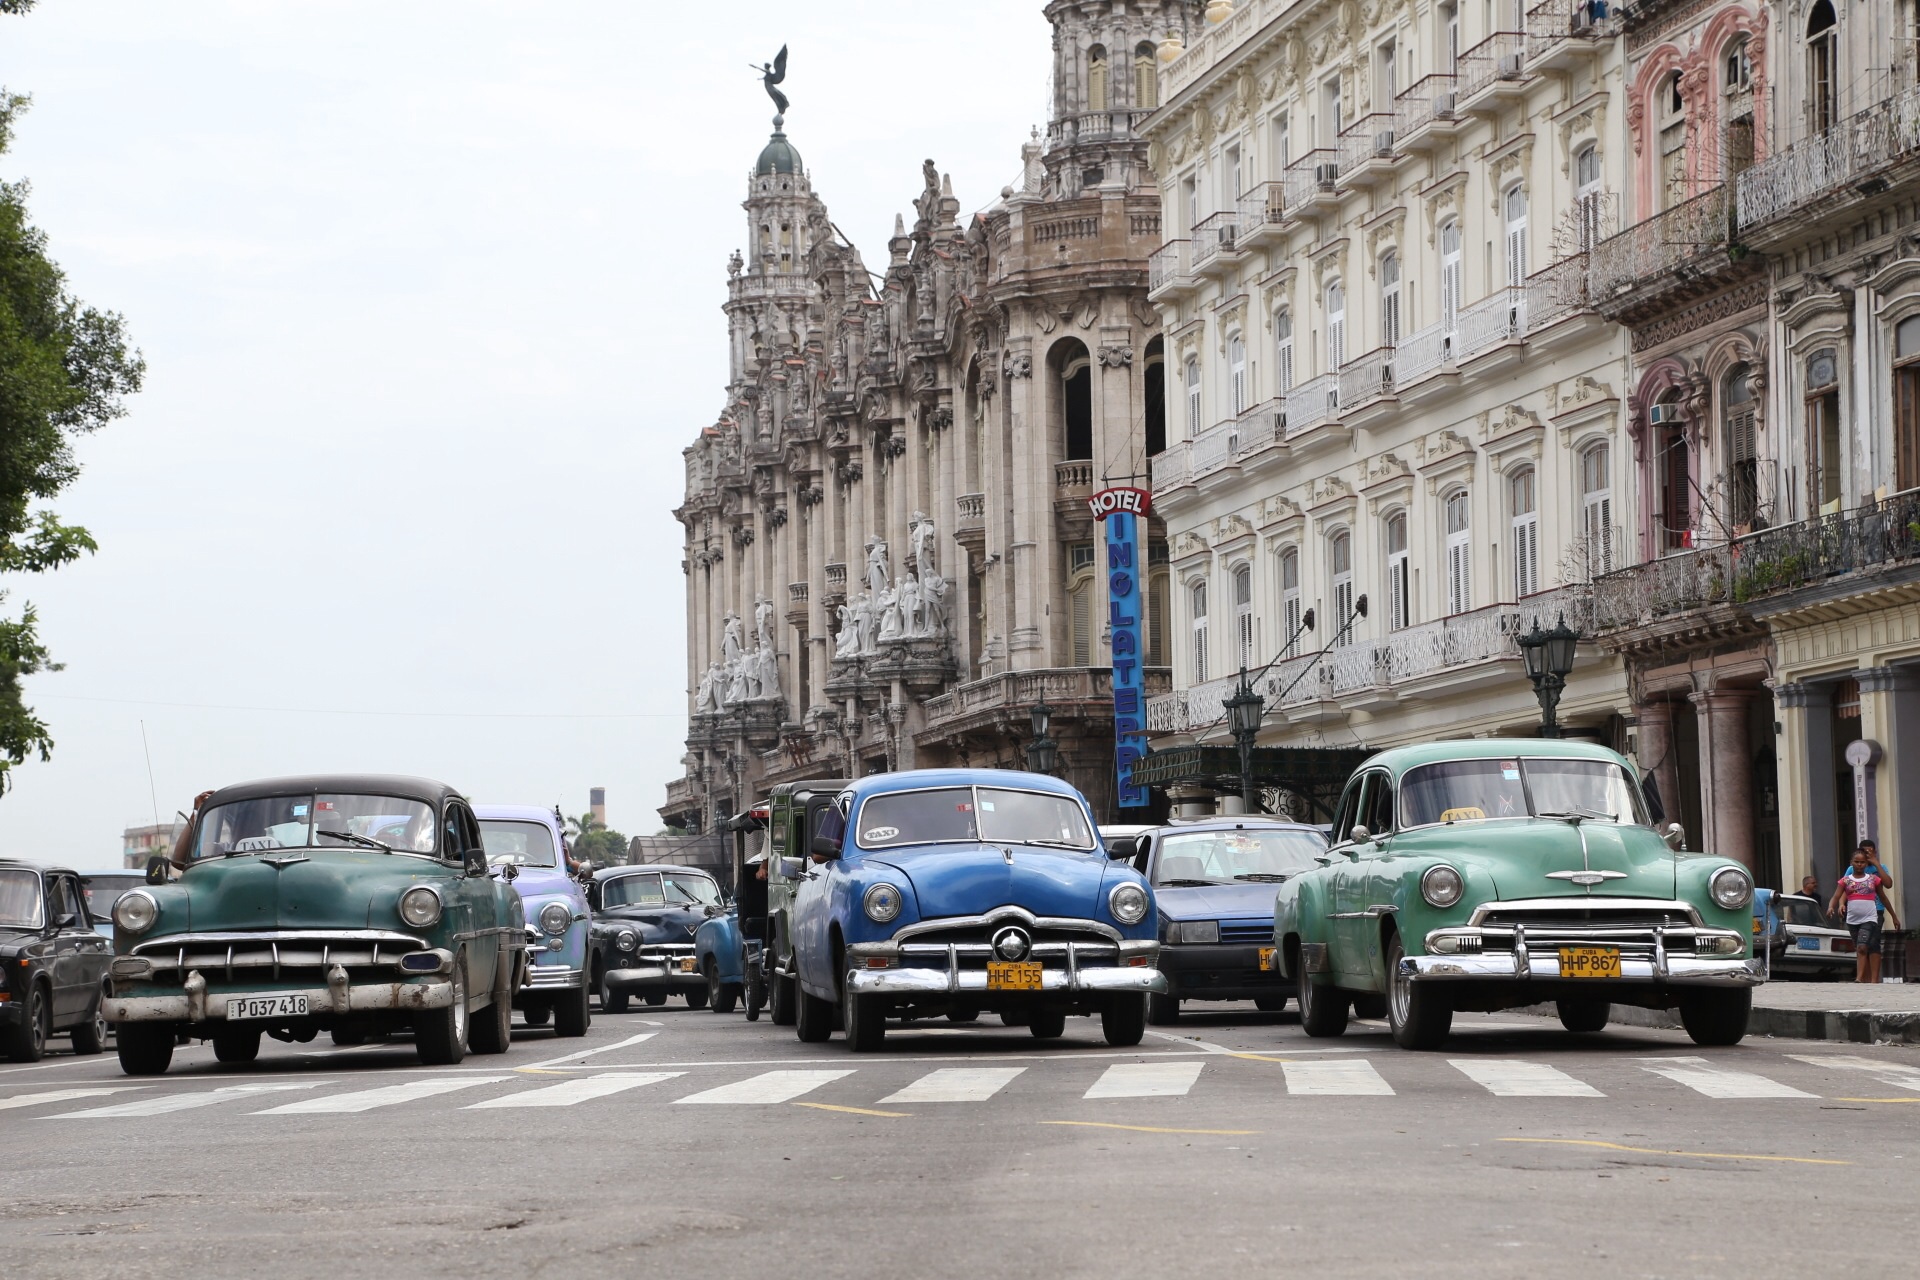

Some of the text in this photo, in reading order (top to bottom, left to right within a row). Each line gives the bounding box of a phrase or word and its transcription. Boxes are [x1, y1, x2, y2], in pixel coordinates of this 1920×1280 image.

[1088, 490, 1142, 517] HOTEL
[1108, 514, 1141, 800] INGLATERRA
[1445, 811, 1479, 821] TAXI
[867, 829, 896, 839] TAXI
[240, 840, 271, 851] TAXI
[1561, 955, 1618, 970] HHP 867
[989, 969, 1040, 983] HHE 155
[238, 998, 306, 1017] P 037 418
